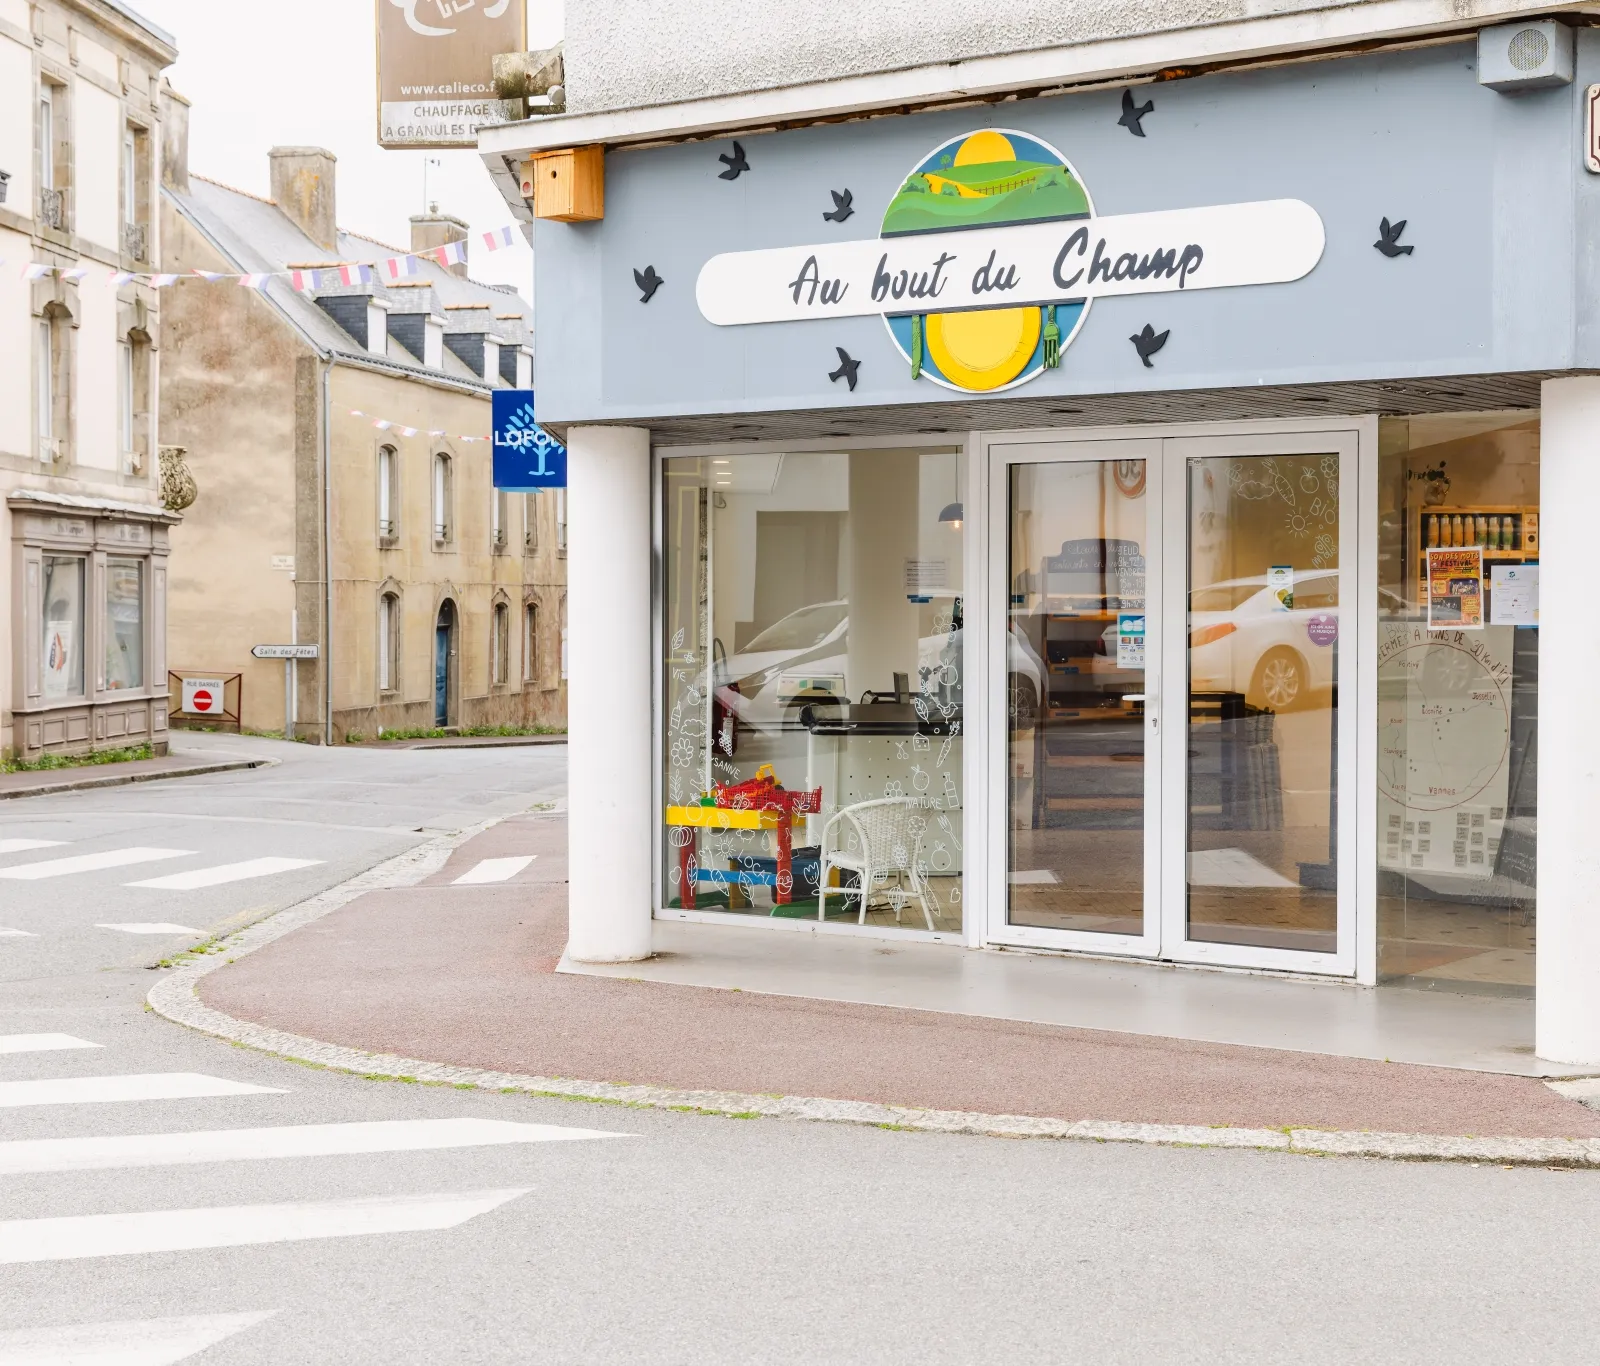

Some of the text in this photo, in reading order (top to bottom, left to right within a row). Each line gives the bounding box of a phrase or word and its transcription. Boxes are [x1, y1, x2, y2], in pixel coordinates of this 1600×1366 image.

[400, 80, 497, 96] www.calieco.f
[413, 104, 490, 118] CHAUFFAGE
[397, 123, 466, 138] GRANULES
[788, 226, 1205, 307] Au bout du Champ
[1309, 497, 1336, 525] BIO
[1431, 552, 1480, 561] SON DES MOTS
[1440, 560, 1473, 568] FESTIVAL
[259, 647, 315, 656] Salle des Fêtes
[904, 796, 943, 811] NATURE
[737, 848, 772, 889] LOCAL
